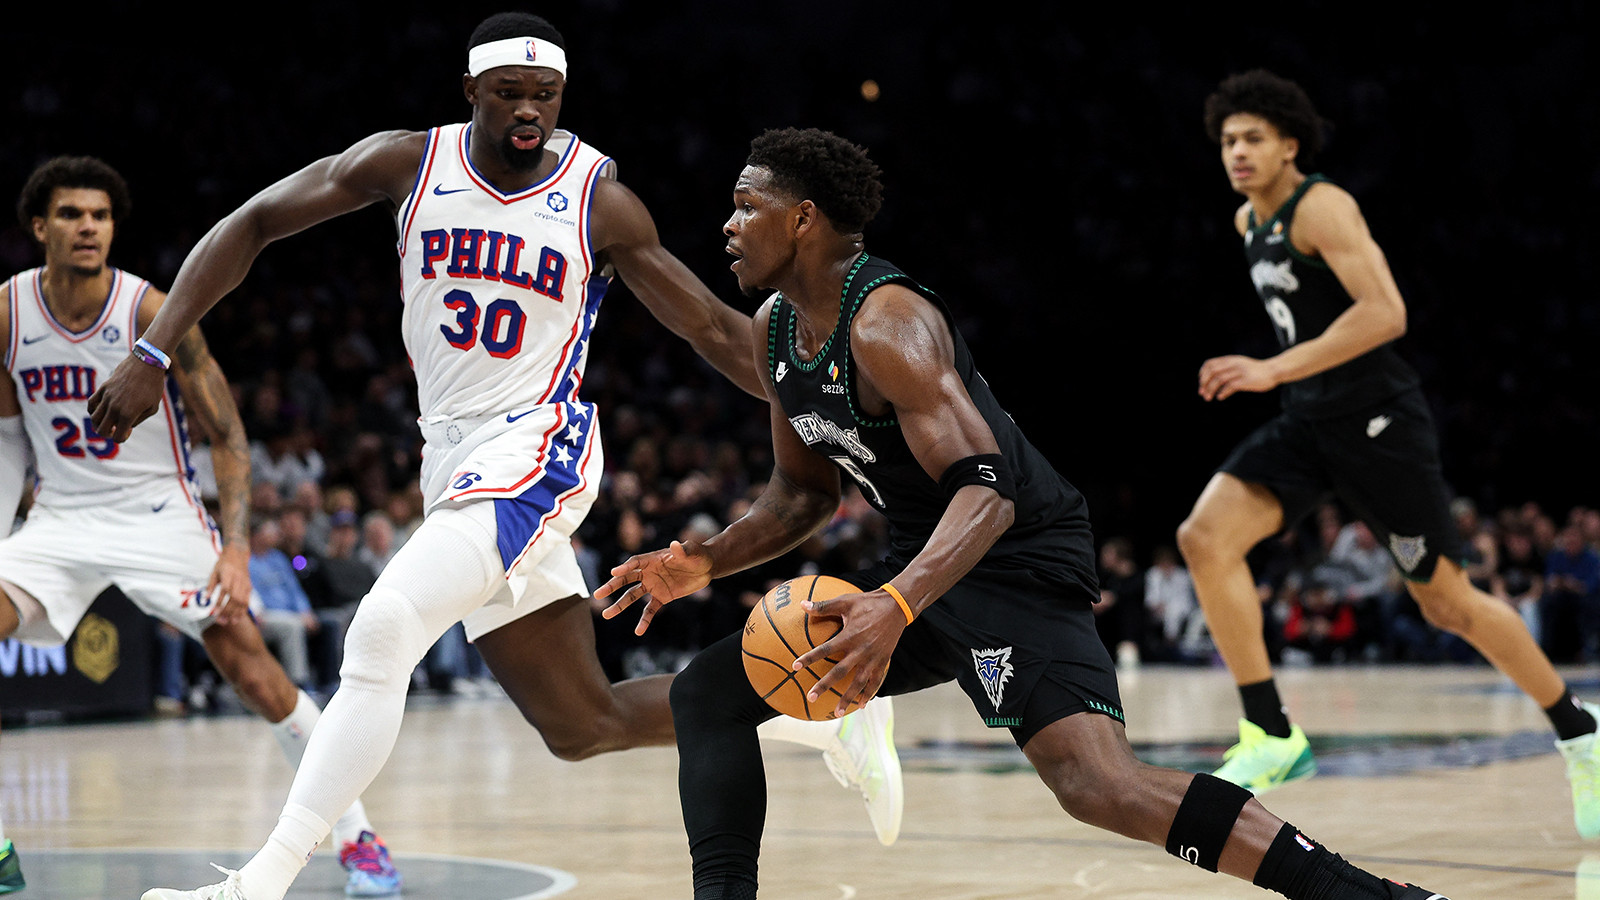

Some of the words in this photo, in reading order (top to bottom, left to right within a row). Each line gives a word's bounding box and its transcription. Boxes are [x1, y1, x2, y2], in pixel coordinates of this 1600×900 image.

[534, 211, 575, 227] crypto.com
[421, 227, 568, 302] PHILA
[440, 288, 527, 359] 30
[821, 382, 845, 395] sezzle
[51, 416, 120, 460] 25
[977, 464, 997, 482] 5
[1180, 844, 1199, 865] 5
